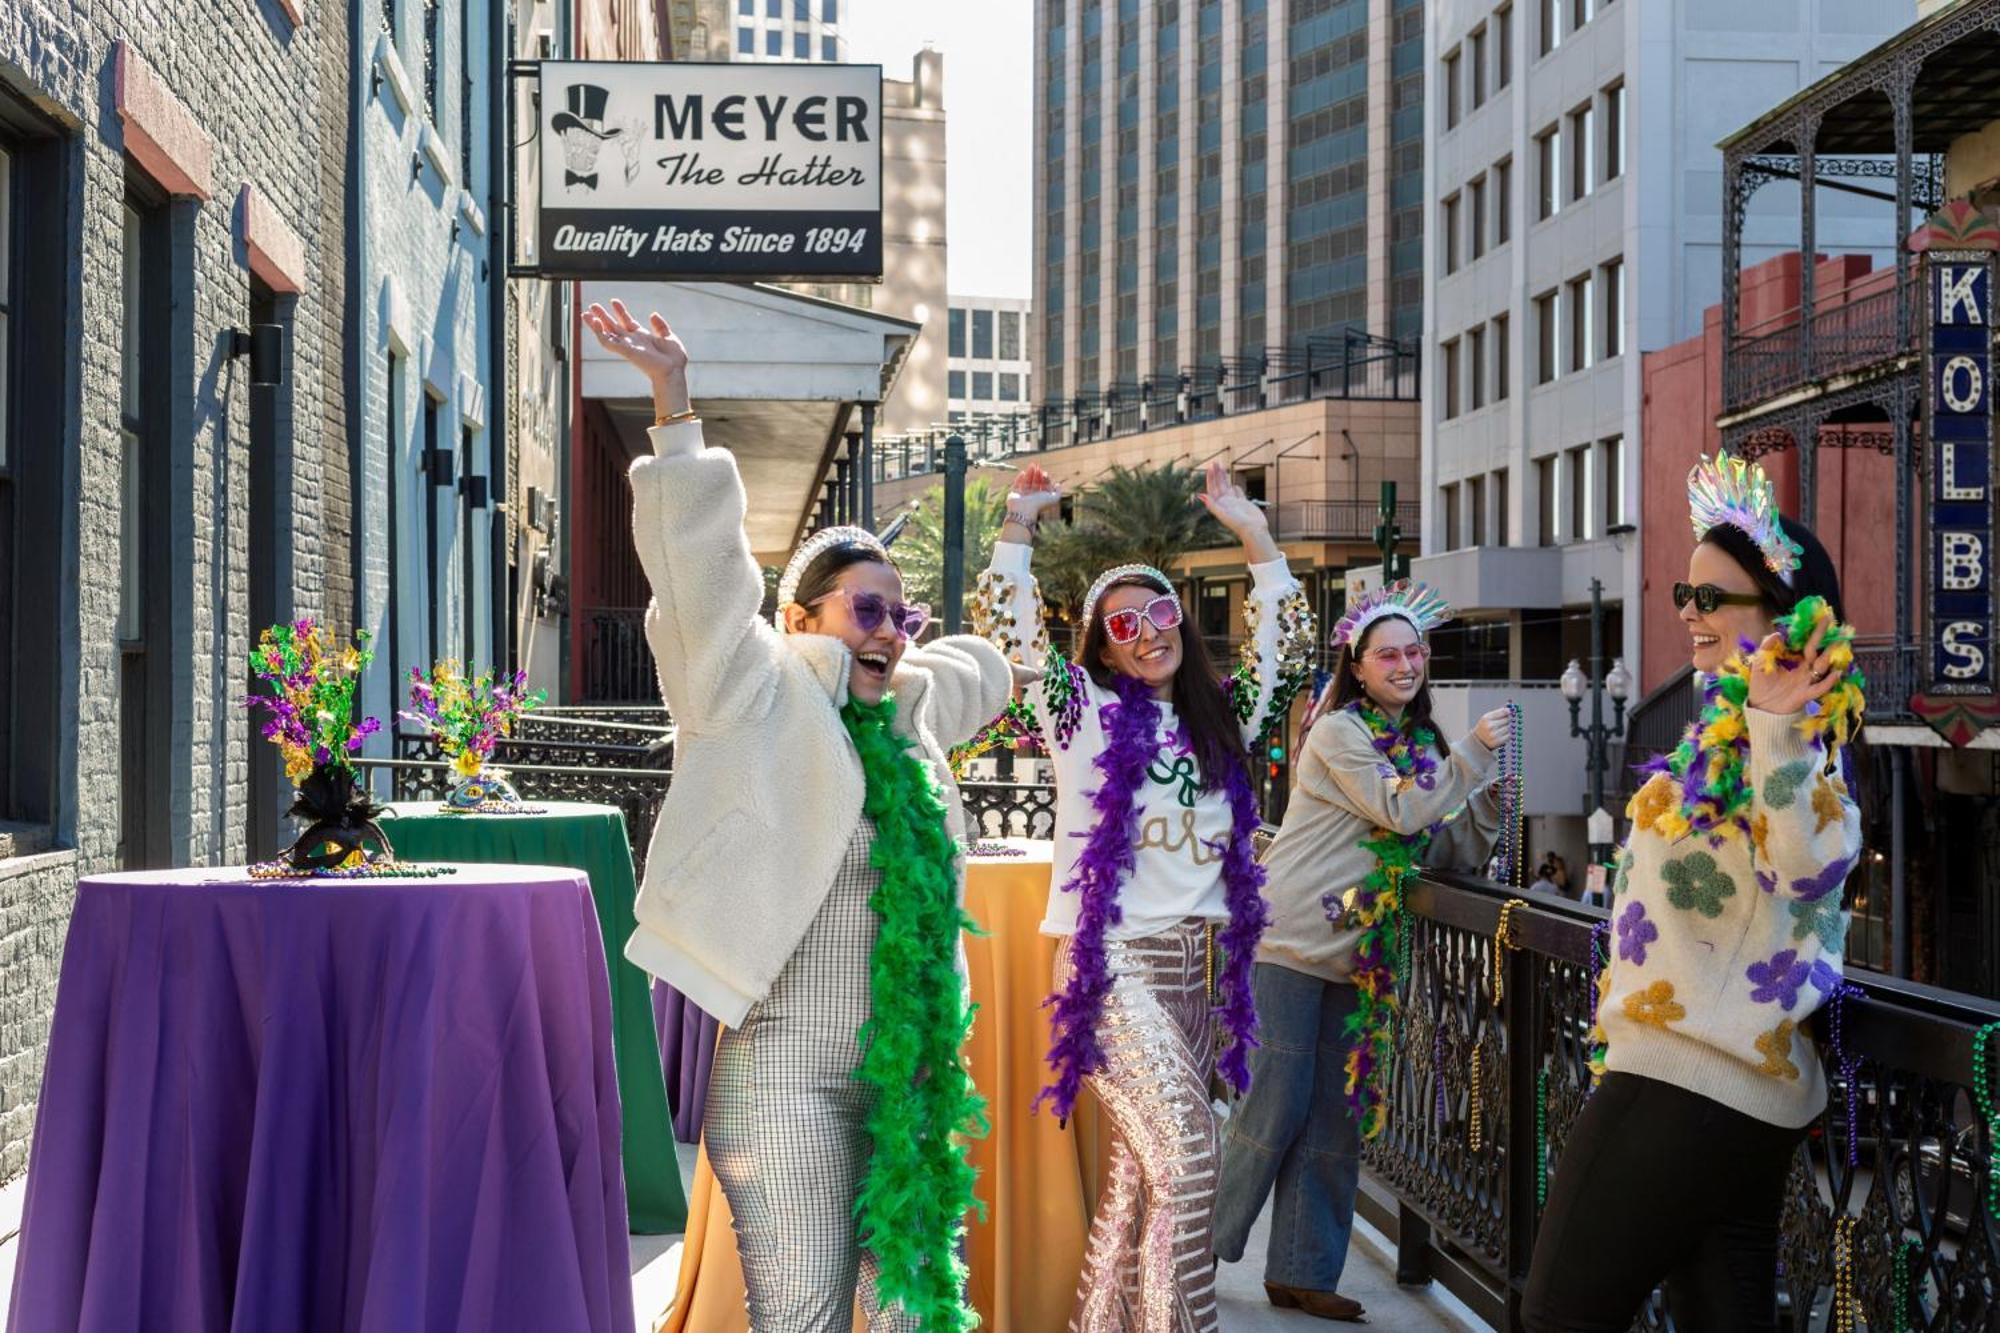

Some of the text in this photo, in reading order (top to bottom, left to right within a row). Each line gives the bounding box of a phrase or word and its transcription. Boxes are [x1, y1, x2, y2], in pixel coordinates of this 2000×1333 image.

[654, 94, 870, 142] MEYER
[656, 152, 866, 187] The Hatter
[554, 225, 867, 258] Quality Hats Since 1894
[1941, 267, 1985, 680] KOLBS
